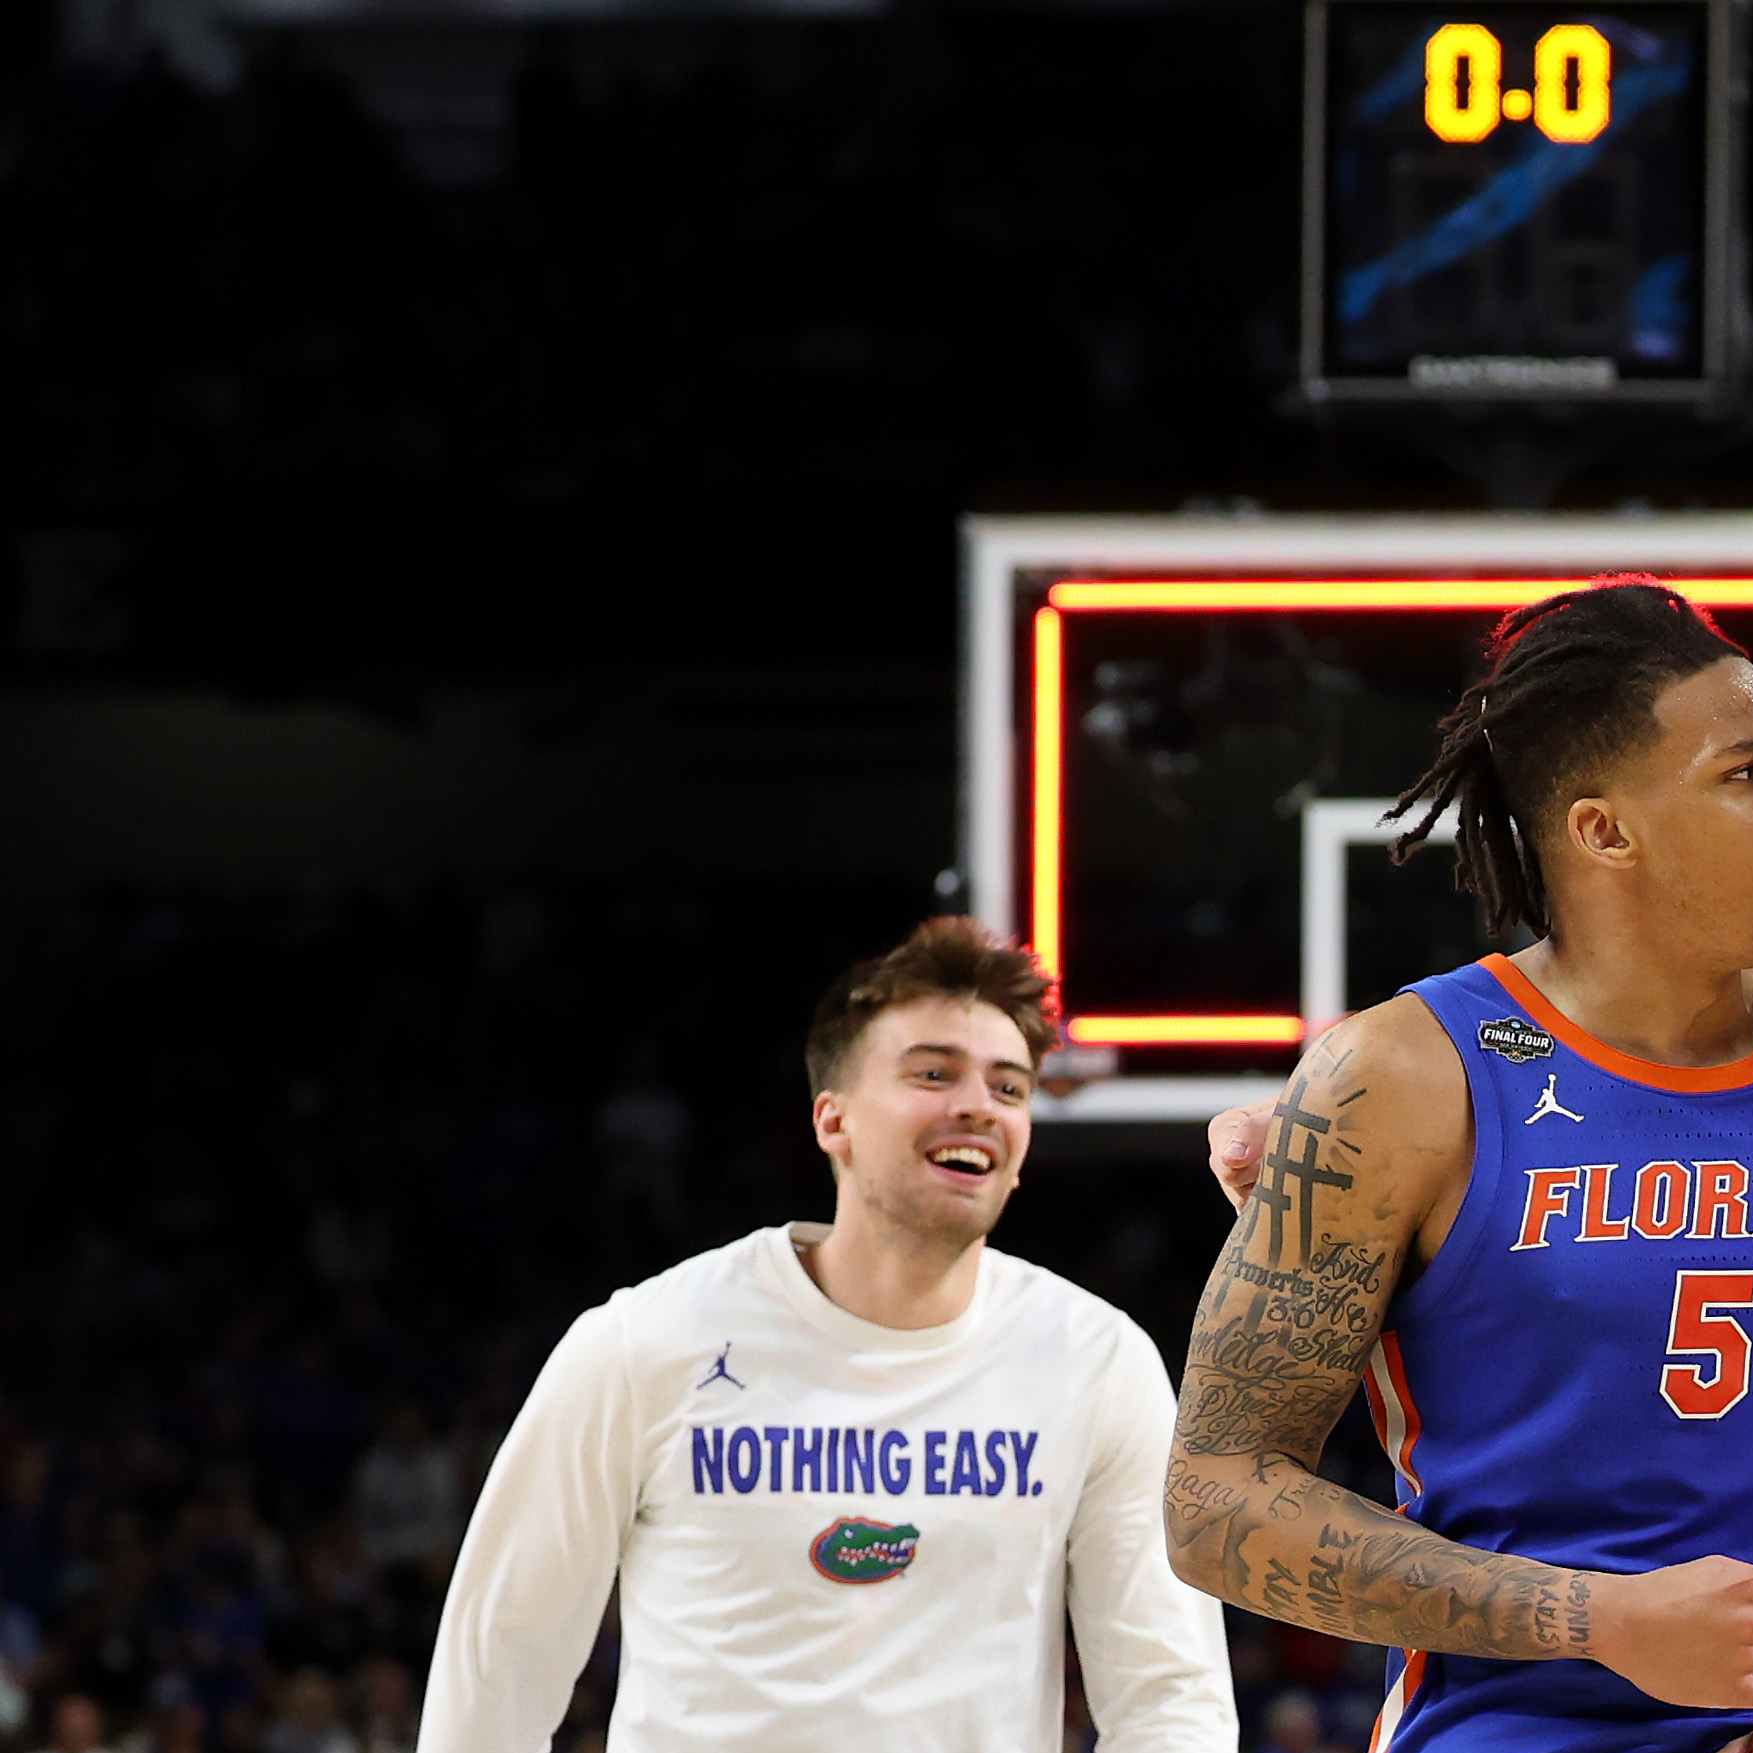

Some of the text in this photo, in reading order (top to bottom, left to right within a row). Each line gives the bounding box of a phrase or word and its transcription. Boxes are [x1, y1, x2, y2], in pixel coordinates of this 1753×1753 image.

[1424, 23, 1611, 144] 0.0
[1483, 1028, 1516, 1043] FINAL
[1517, 1033, 1550, 1048] FOUR
[692, 1426, 1043, 1497] NOTHING EASY.
